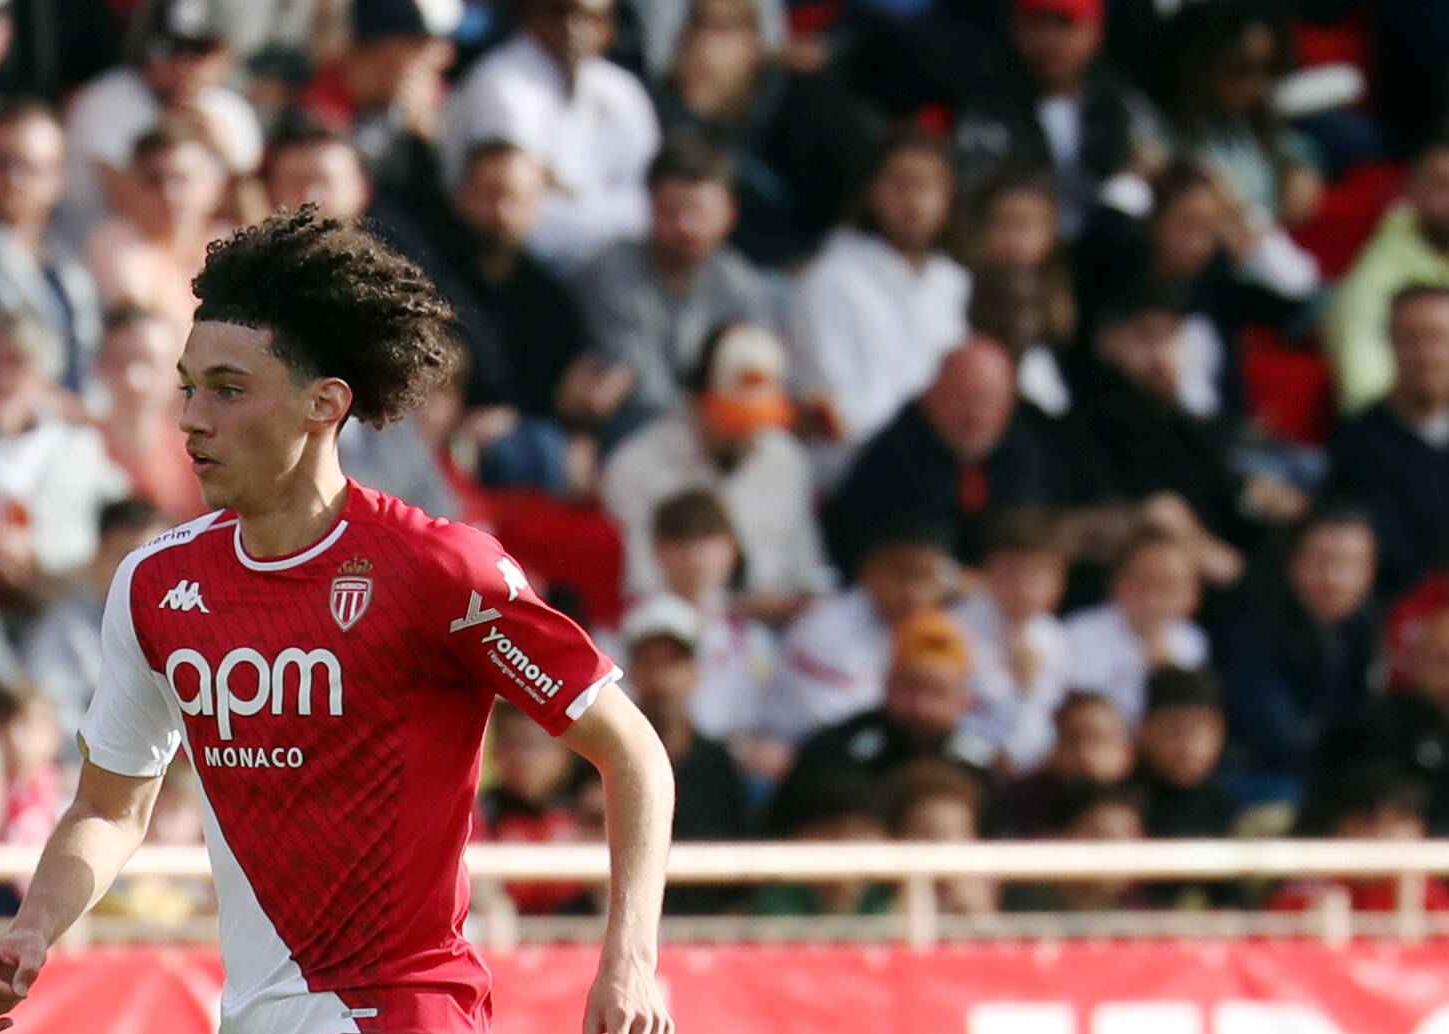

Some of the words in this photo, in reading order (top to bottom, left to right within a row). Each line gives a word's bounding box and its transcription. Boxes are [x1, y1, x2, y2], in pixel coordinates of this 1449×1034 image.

[165, 646, 344, 741] apm
[480, 625, 564, 699] yomoni
[204, 746, 304, 768] MONACO
